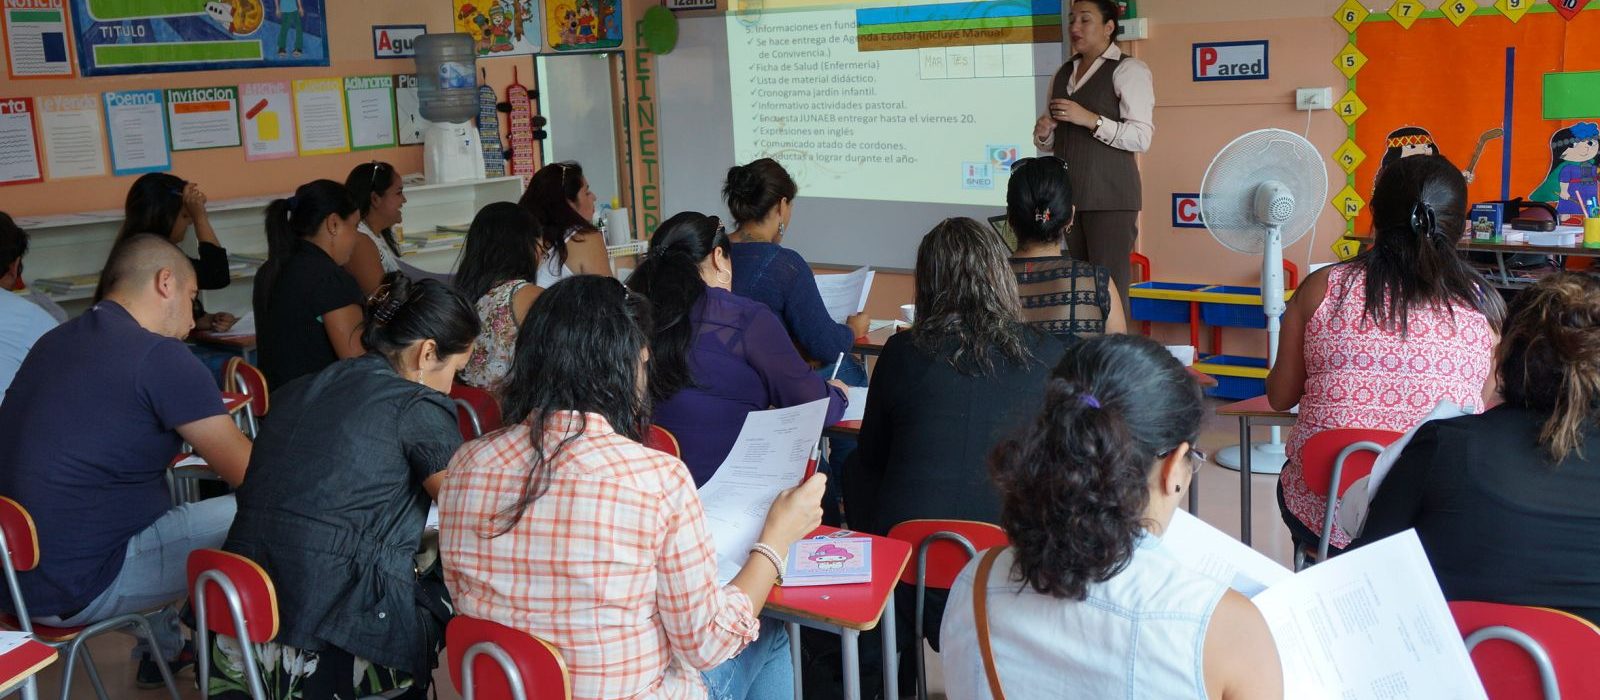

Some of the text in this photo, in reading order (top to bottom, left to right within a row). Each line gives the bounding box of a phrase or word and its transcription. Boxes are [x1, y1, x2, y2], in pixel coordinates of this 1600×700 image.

[1403, 5, 1412, 16] 7
[1455, 3, 1465, 14] 8
[1346, 11, 1354, 22] 6
[99, 25, 145, 38] TITULO
[755, 23, 818, 33] Informaciones
[820, 23, 832, 31] en
[378, 31, 415, 53] Agu
[756, 38, 767, 46] Se
[769, 37, 790, 46] hace
[792, 36, 826, 46] entrega
[828, 35, 841, 43] de
[843, 33, 878, 44] Agenda
[882, 32, 918, 42] Escolar
[759, 49, 770, 59] de
[951, 55, 968, 66] TES
[1200, 47, 1262, 76] Pared
[1346, 56, 1354, 67] 5
[756, 63, 778, 72] Ficha
[780, 62, 791, 71] de
[793, 62, 818, 71] Salud
[398, 74, 417, 88] Pla
[757, 76, 777, 85] Lista
[778, 75, 789, 84] de
[791, 74, 829, 84] material
[105, 91, 155, 106] Poema
[167, 88, 234, 103] Invitacion
[758, 88, 811, 99] Cronograma
[758, 100, 908, 110] Informativo actividades pastoral.
[1344, 104, 1352, 114] 4
[759, 113, 977, 125] Encuesta JUNAEB entregar hasta el viernes 20.
[760, 126, 854, 137] Expresiones en inglés
[760, 140, 907, 150] Comunicado atado de cordones.
[816, 152, 842, 163] lograr
[845, 153, 882, 163] durante
[884, 154, 893, 163] el
[1344, 154, 1353, 165] 3
[1347, 204, 1357, 212] 2
[1343, 245, 1350, 256] 1
